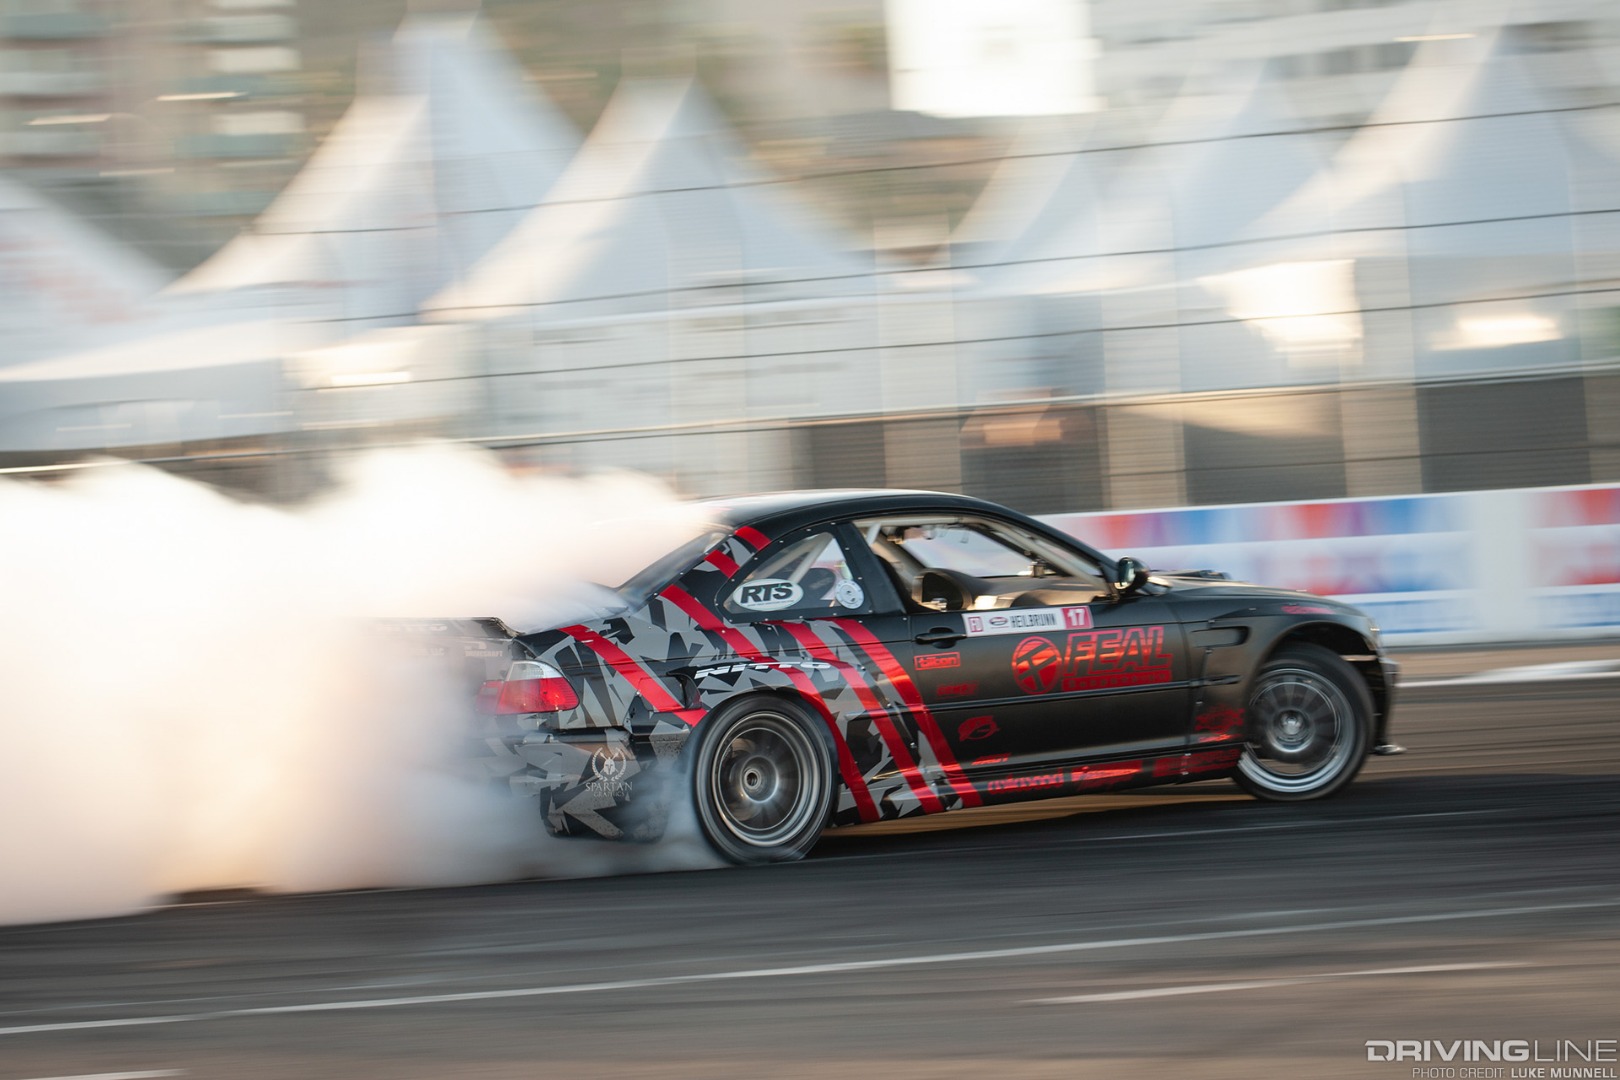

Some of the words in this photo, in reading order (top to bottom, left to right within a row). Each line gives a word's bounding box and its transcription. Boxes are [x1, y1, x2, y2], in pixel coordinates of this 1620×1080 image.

[741, 583, 793, 604] RTS
[1010, 614, 1057, 628] HEILBRUNN
[1068, 608, 1086, 626] 17
[1063, 626, 1174, 677] FEAL
[585, 782, 633, 791] SPARTAN
